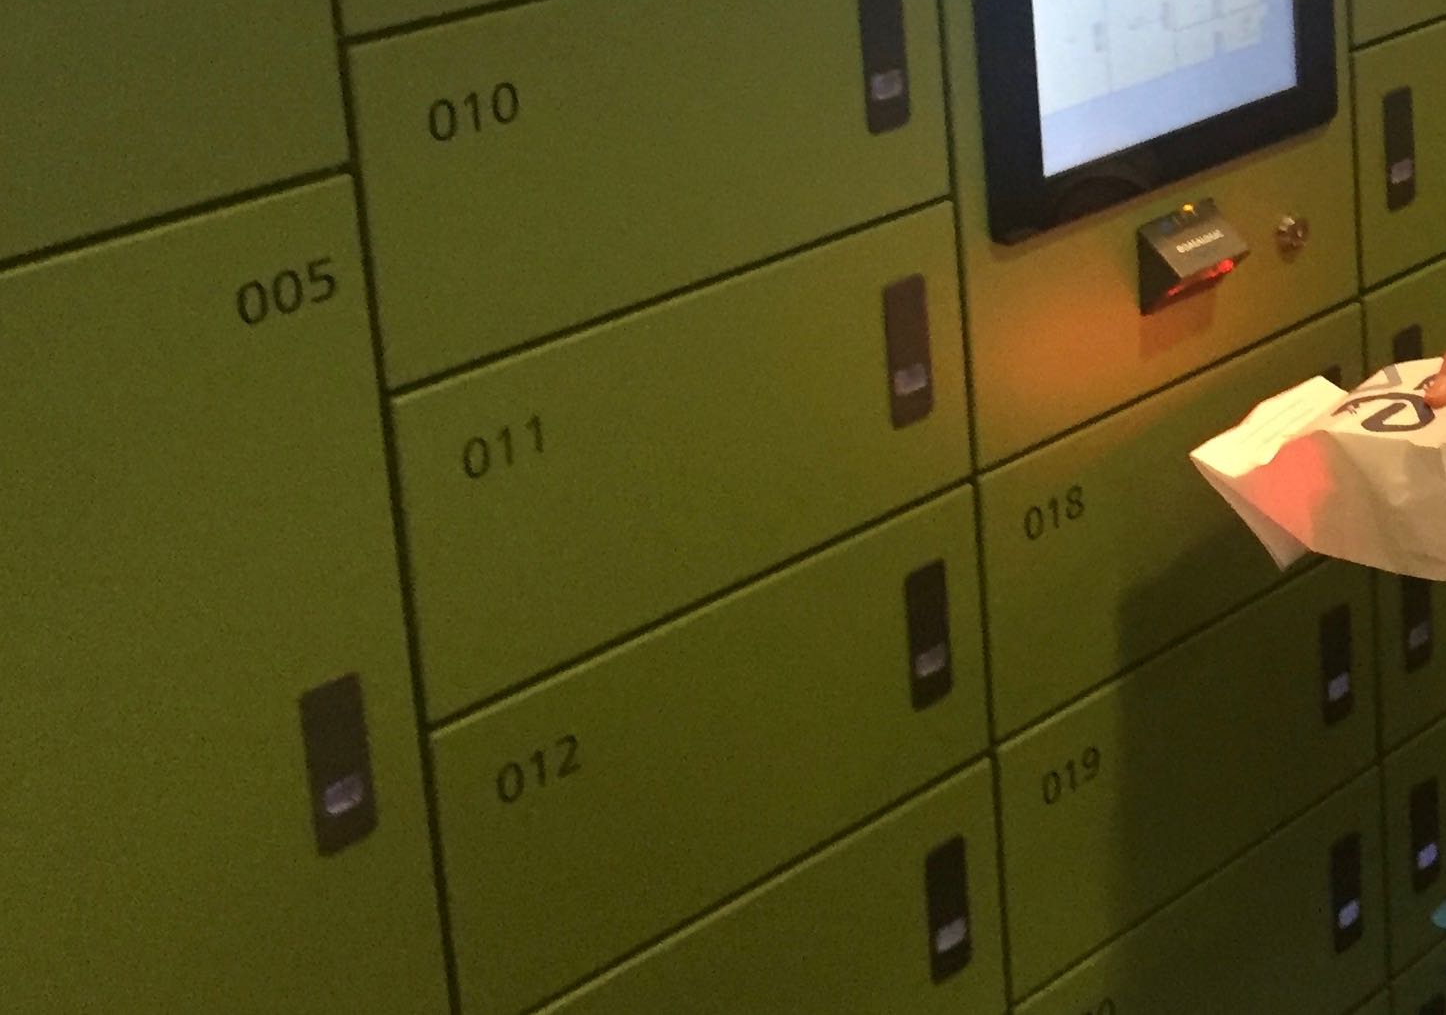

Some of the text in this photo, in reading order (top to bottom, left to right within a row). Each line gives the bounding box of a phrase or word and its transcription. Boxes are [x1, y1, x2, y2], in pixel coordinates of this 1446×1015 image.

[429, 82, 519, 141] 010
[237, 257, 336, 325] 005
[463, 415, 543, 479] 011
[1024, 485, 1085, 541] 018
[495, 735, 581, 803] 012
[1042, 746, 1100, 805] 019
